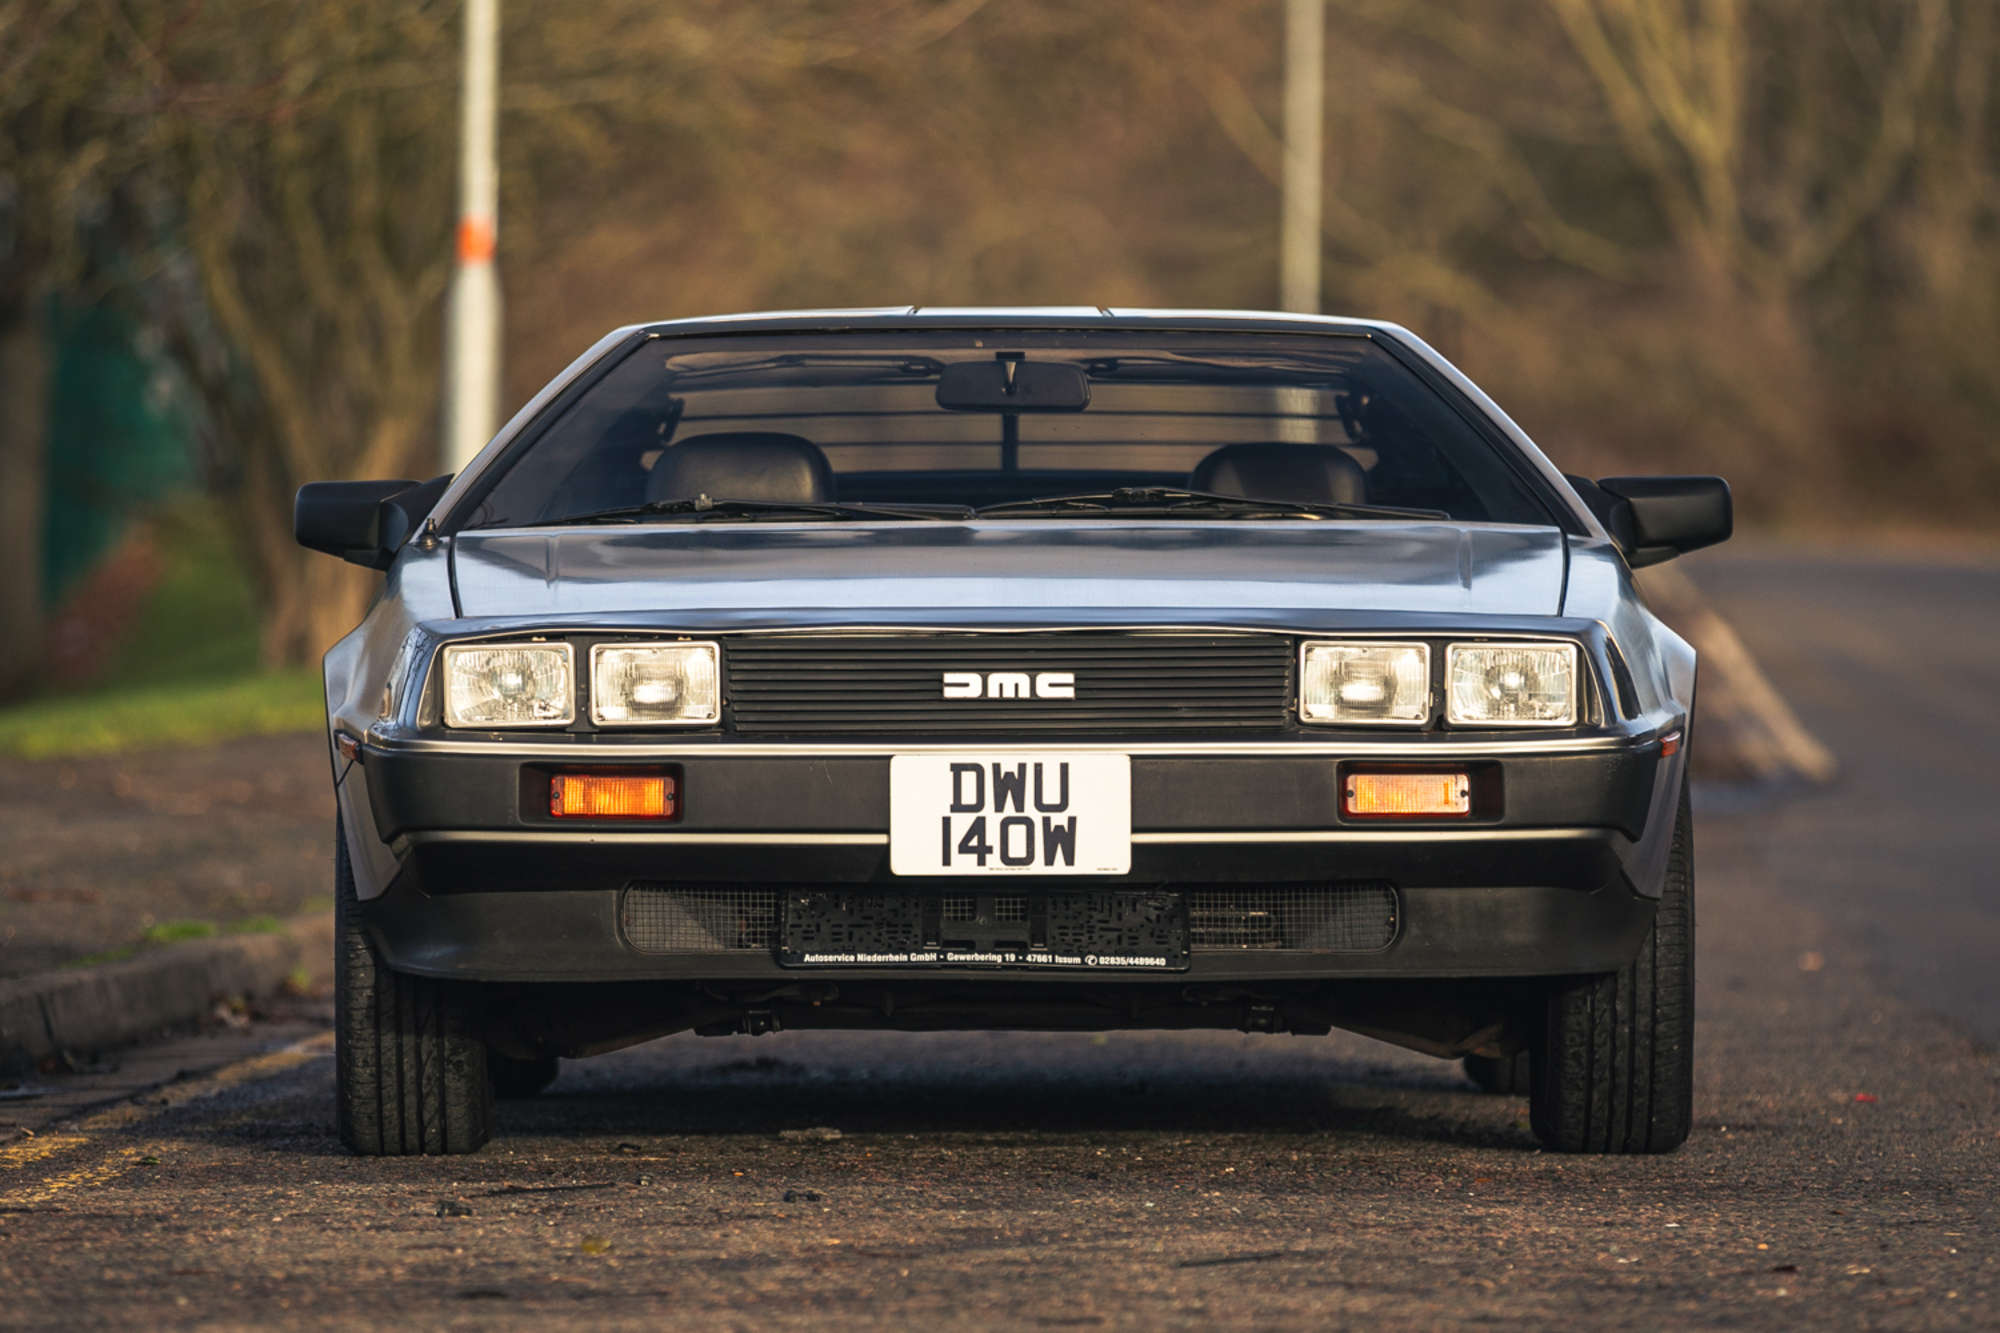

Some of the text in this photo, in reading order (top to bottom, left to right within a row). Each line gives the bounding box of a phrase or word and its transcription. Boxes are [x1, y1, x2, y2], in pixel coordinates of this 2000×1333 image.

[949, 762, 1069, 813] DWU
[941, 816, 1077, 867] 140W
[804, 953, 855, 962] Autoservice
[857, 953, 909, 962] Niederrhein
[910, 952, 937, 962] GmbH
[947, 952, 1002, 964] Gewerbering
[1056, 954, 1082, 965] Issum
